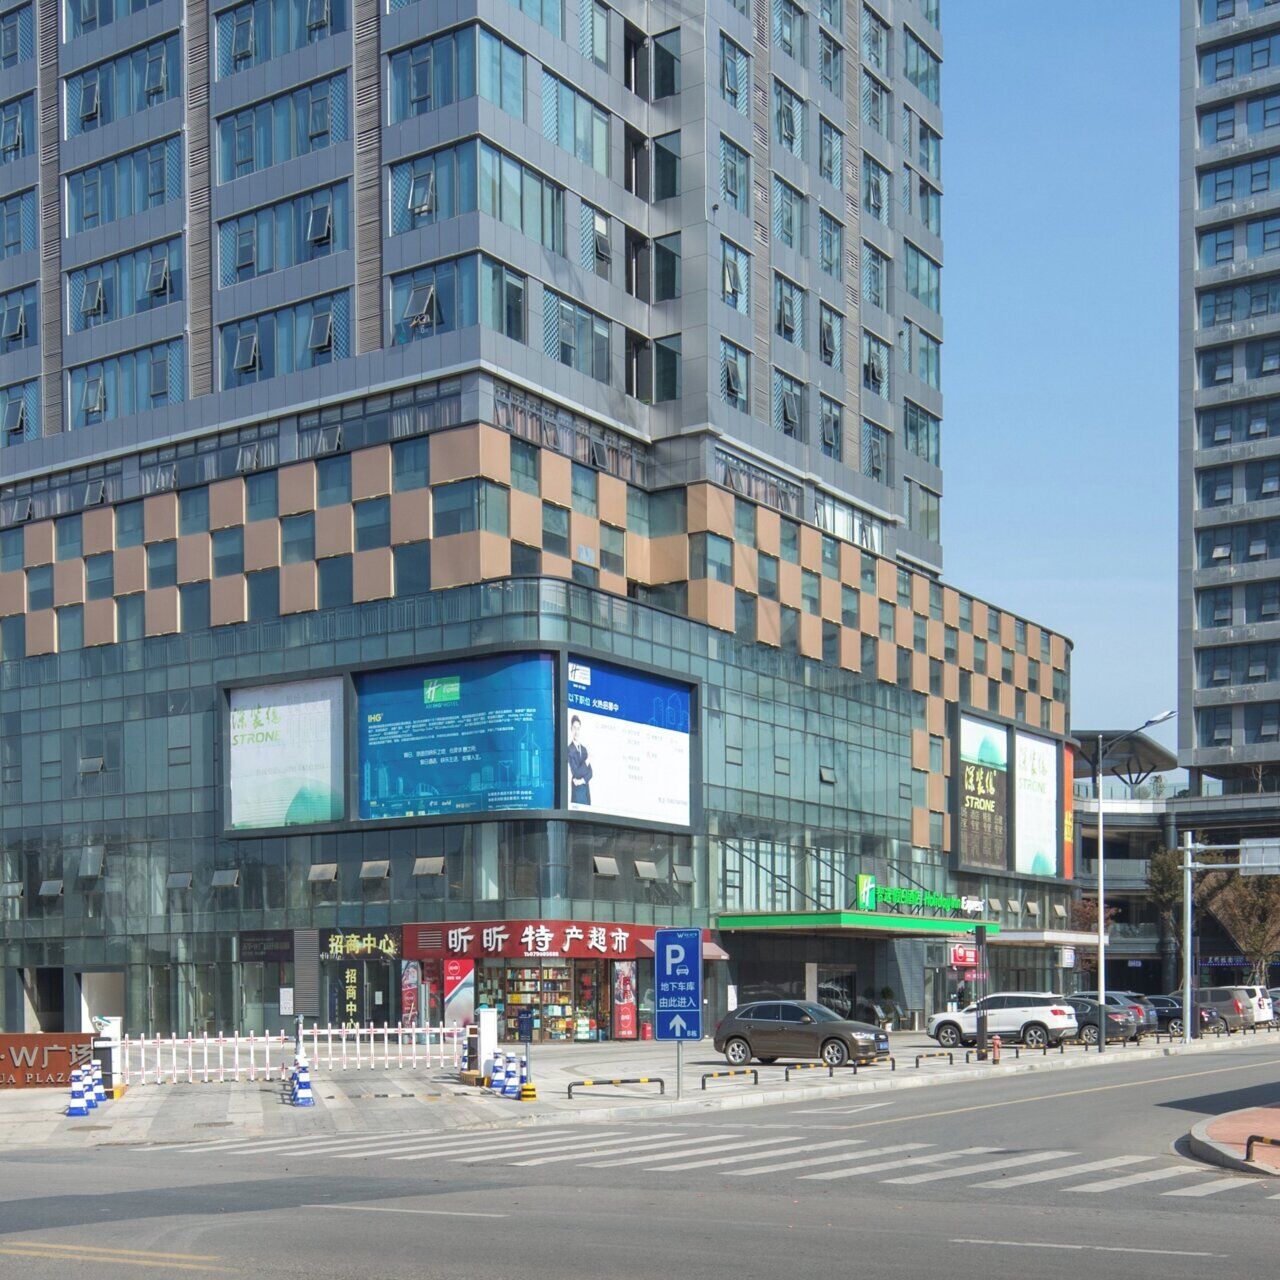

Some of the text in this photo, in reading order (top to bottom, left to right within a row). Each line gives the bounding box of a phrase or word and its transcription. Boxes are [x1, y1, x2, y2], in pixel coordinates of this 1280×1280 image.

[232, 730, 280, 746] STRONE
[965, 795, 995, 813] STRONE
[328, 933, 398, 955] 招商中心
[448, 924, 630, 954] 昕昕特产超市
[665, 944, 685, 975] P
[660, 982, 695, 992] 地下车库
[345, 968, 358, 1030] 招商中心
[660, 997, 696, 1008] 由此进入
